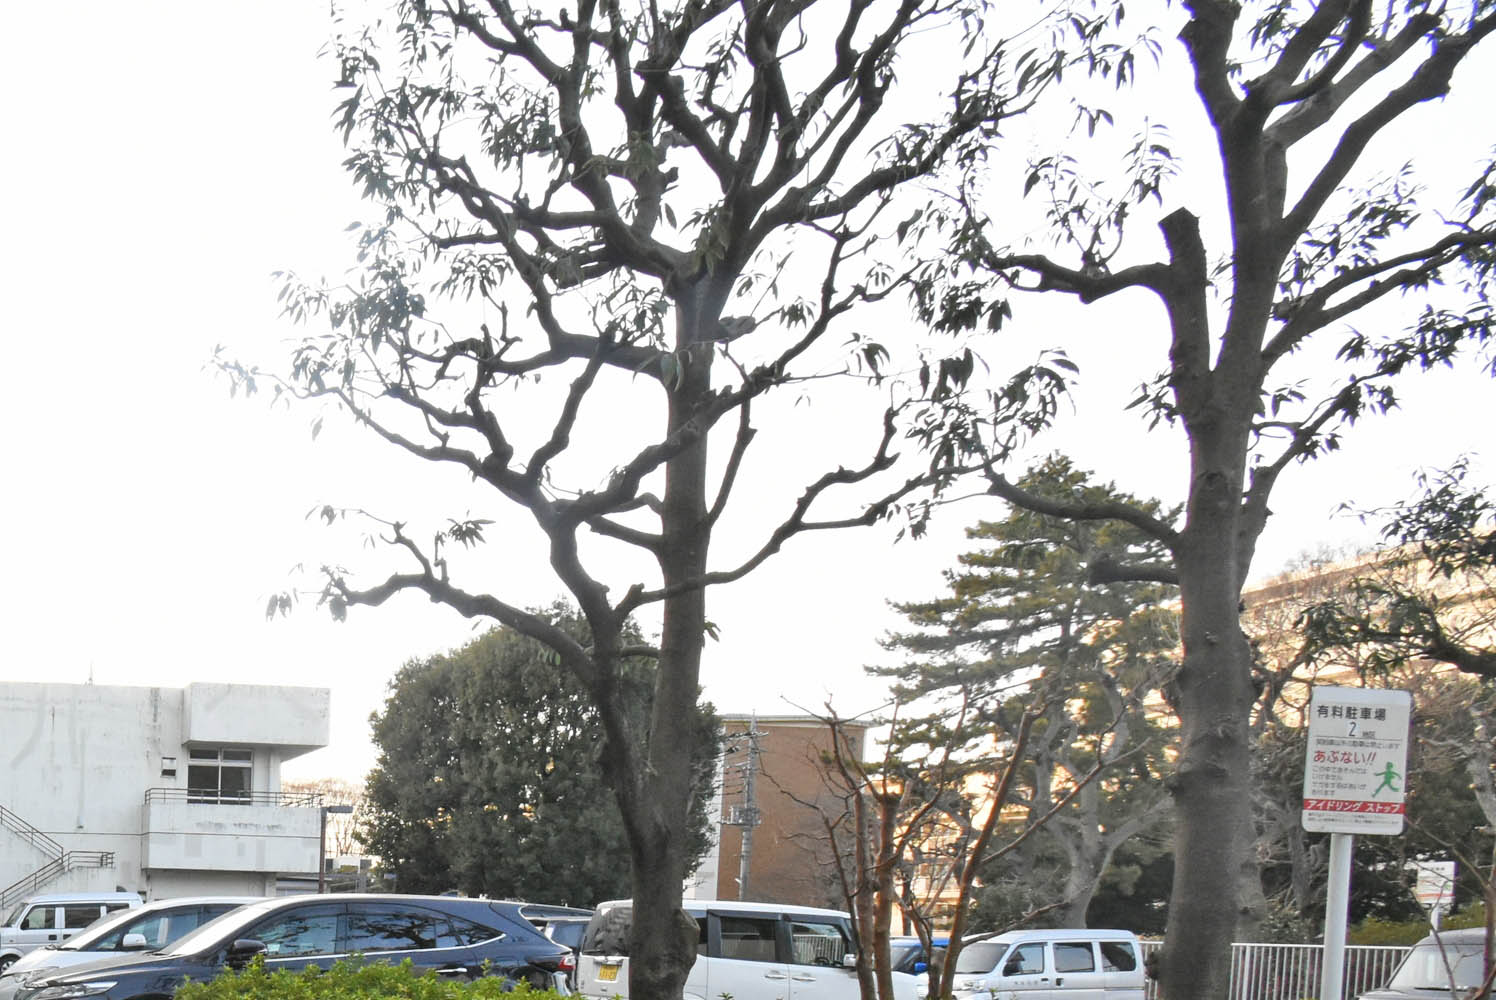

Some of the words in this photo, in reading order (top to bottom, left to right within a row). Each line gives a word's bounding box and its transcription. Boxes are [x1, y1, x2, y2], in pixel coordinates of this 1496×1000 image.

[1317, 705, 1386, 721] 有料駐車場
[1348, 721, 1357, 737] 2
